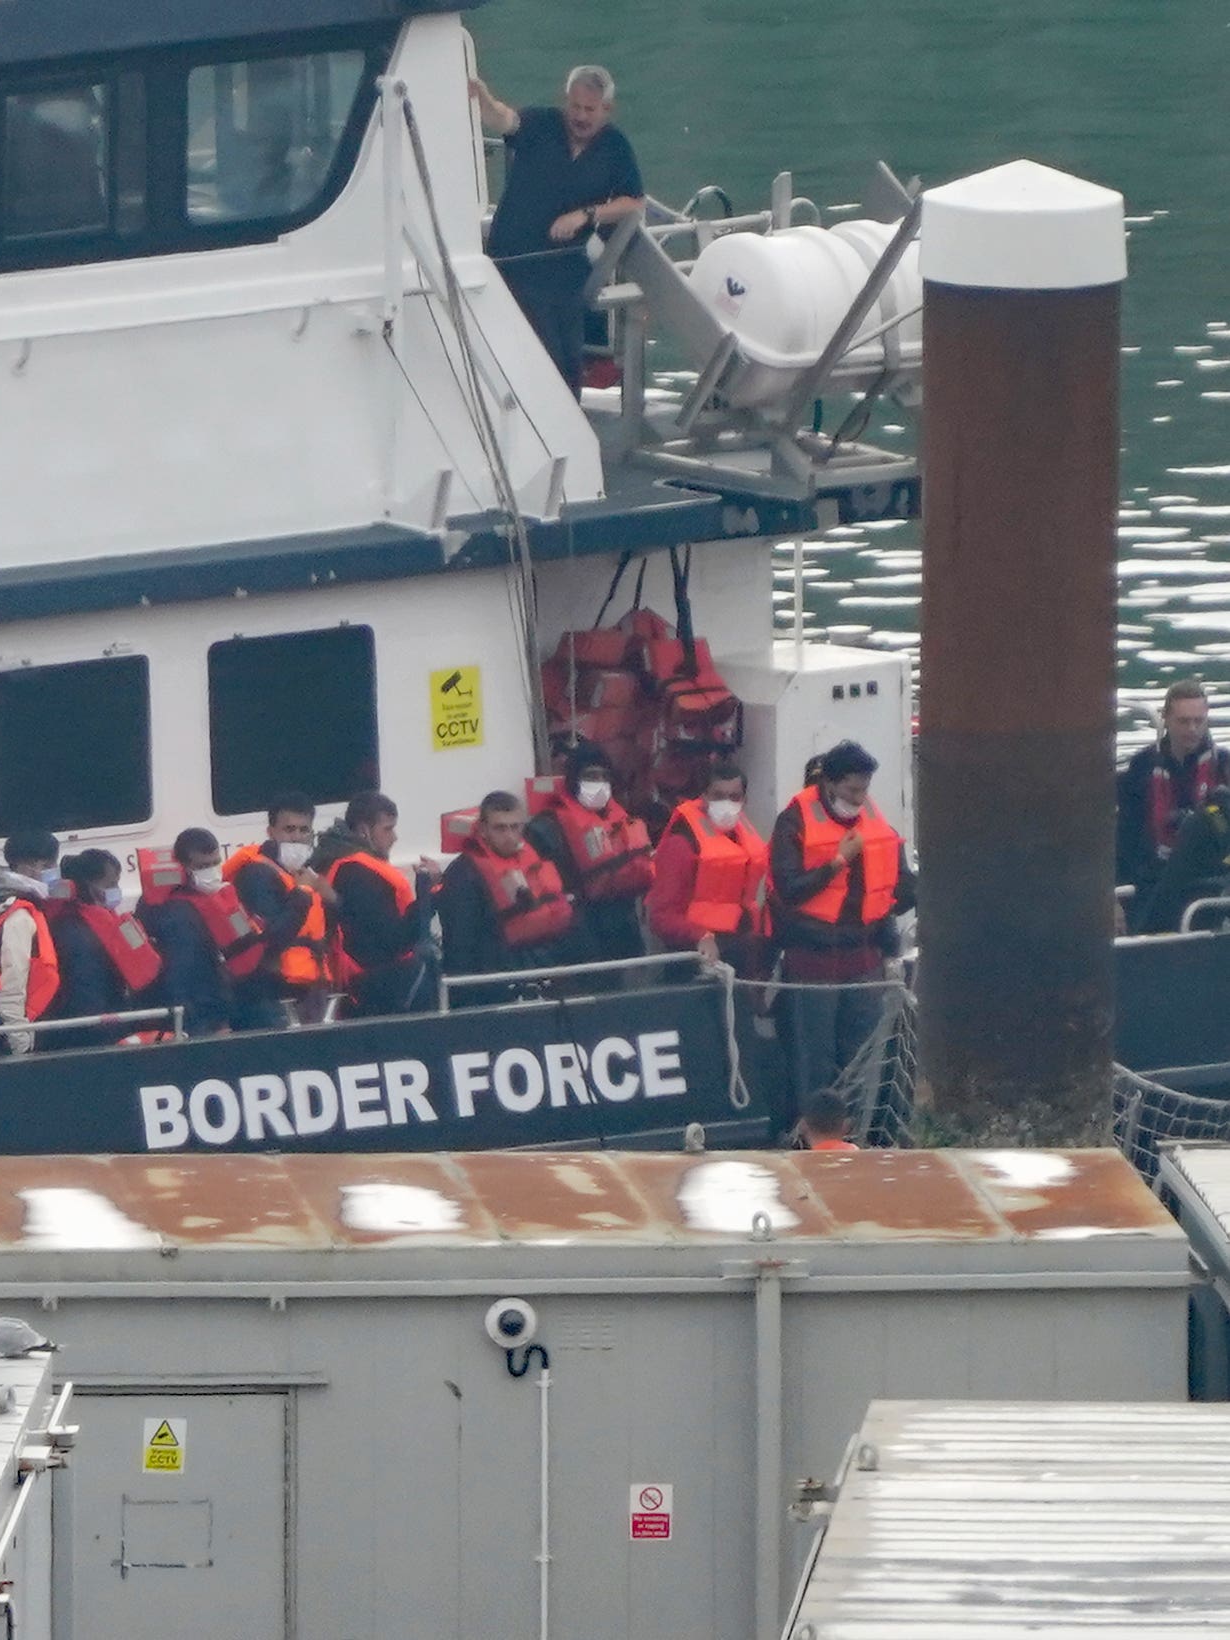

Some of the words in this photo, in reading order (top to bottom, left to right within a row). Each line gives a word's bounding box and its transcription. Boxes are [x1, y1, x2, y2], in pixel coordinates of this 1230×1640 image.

[436, 718, 479, 739] CCTV
[139, 1059, 438, 1149] BORDER
[451, 1030, 687, 1118] FORCE
[149, 1455, 178, 1464] CCTV
